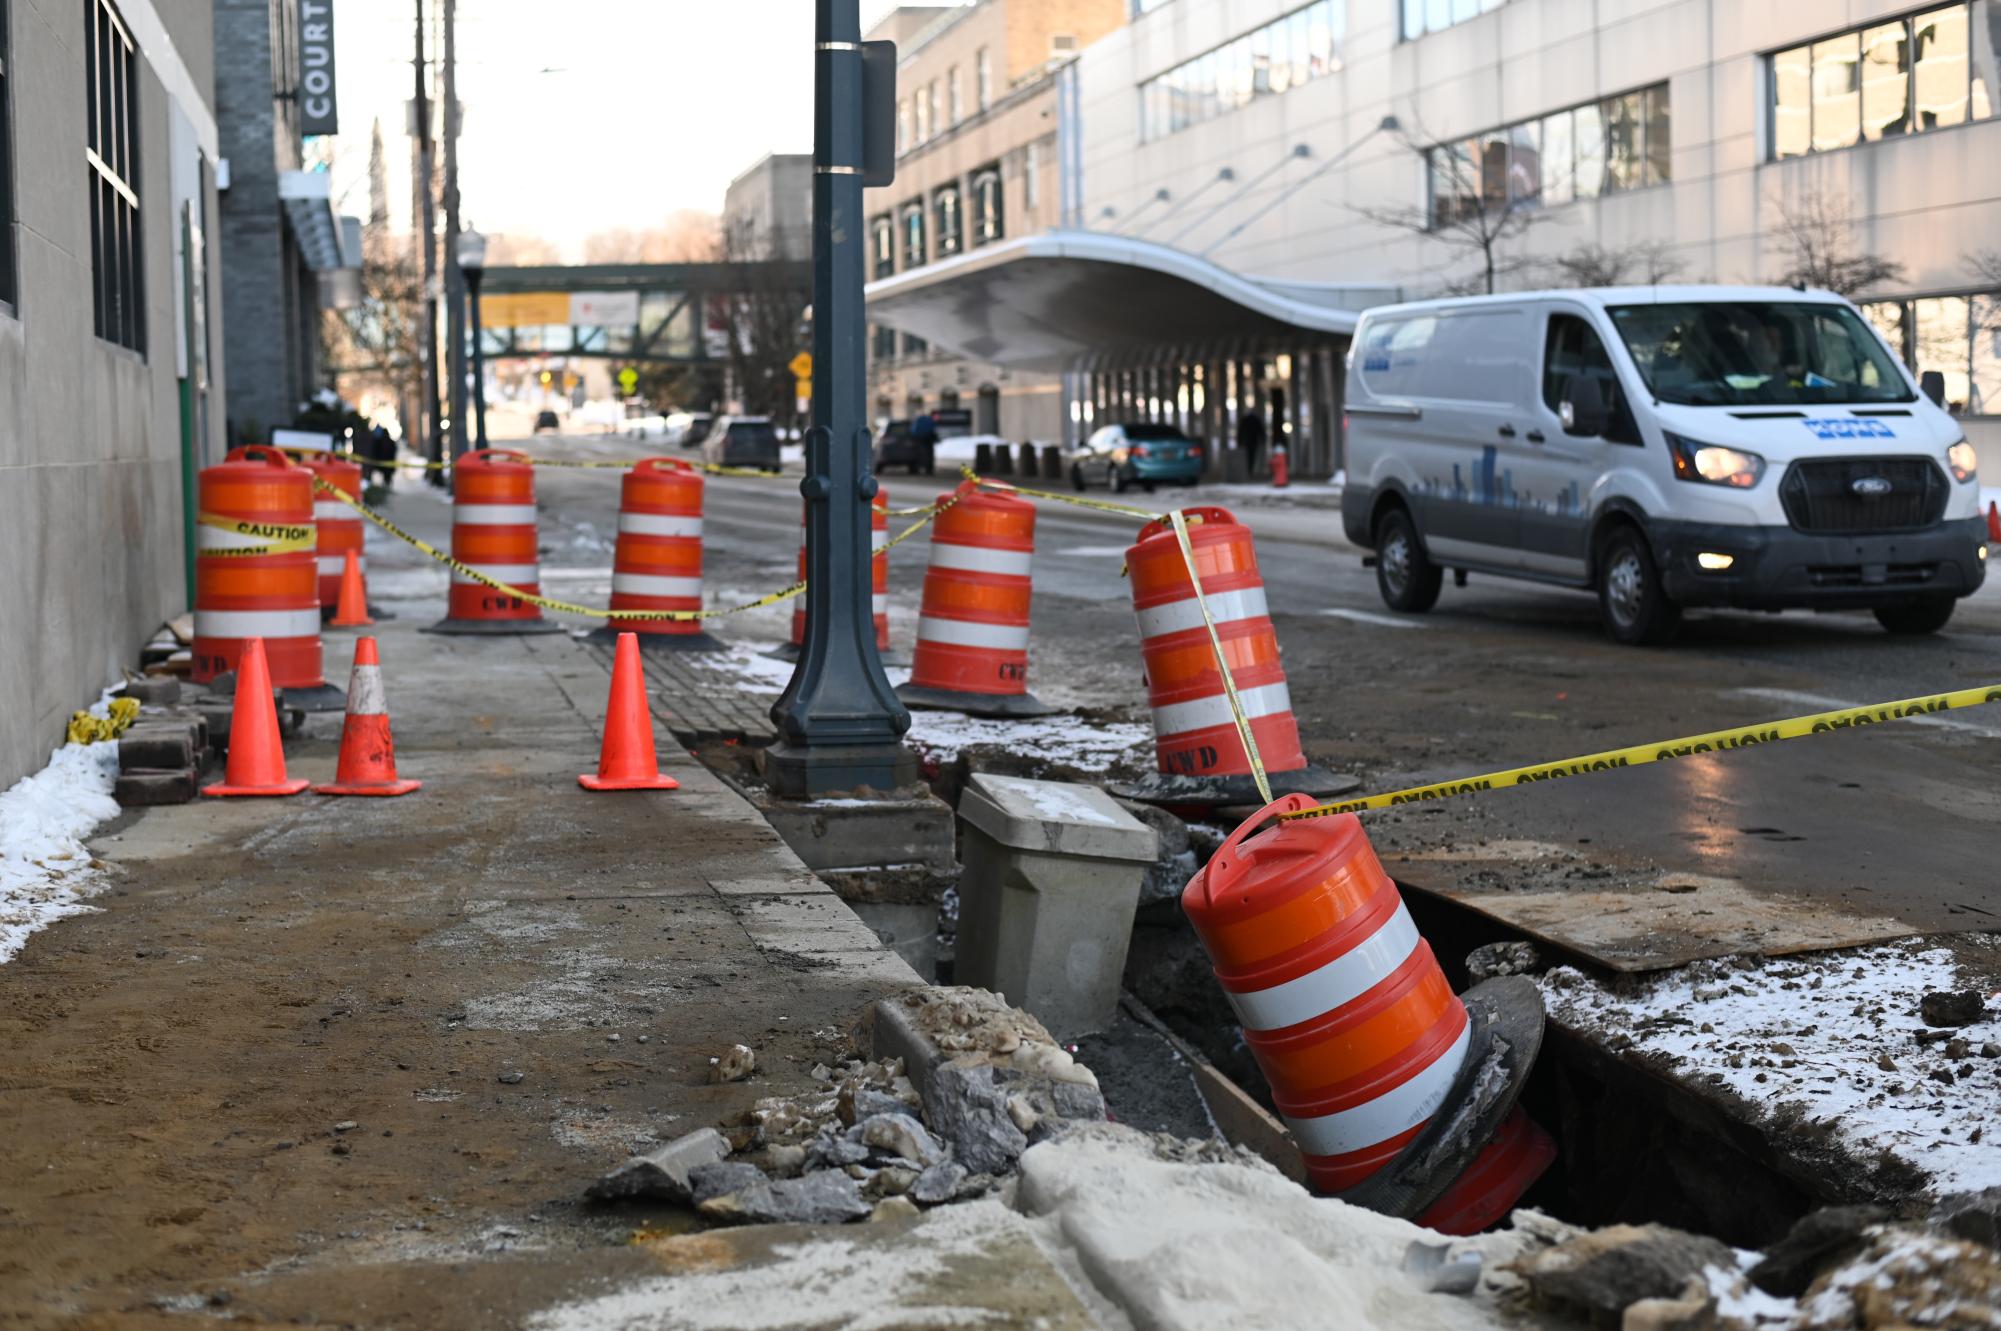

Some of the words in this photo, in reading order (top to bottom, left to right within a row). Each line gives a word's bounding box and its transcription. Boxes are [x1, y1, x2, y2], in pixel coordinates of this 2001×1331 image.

[303, 1, 331, 118] COURT
[237, 522, 309, 540] CAUTION
[1165, 746, 1218, 774] CWD
